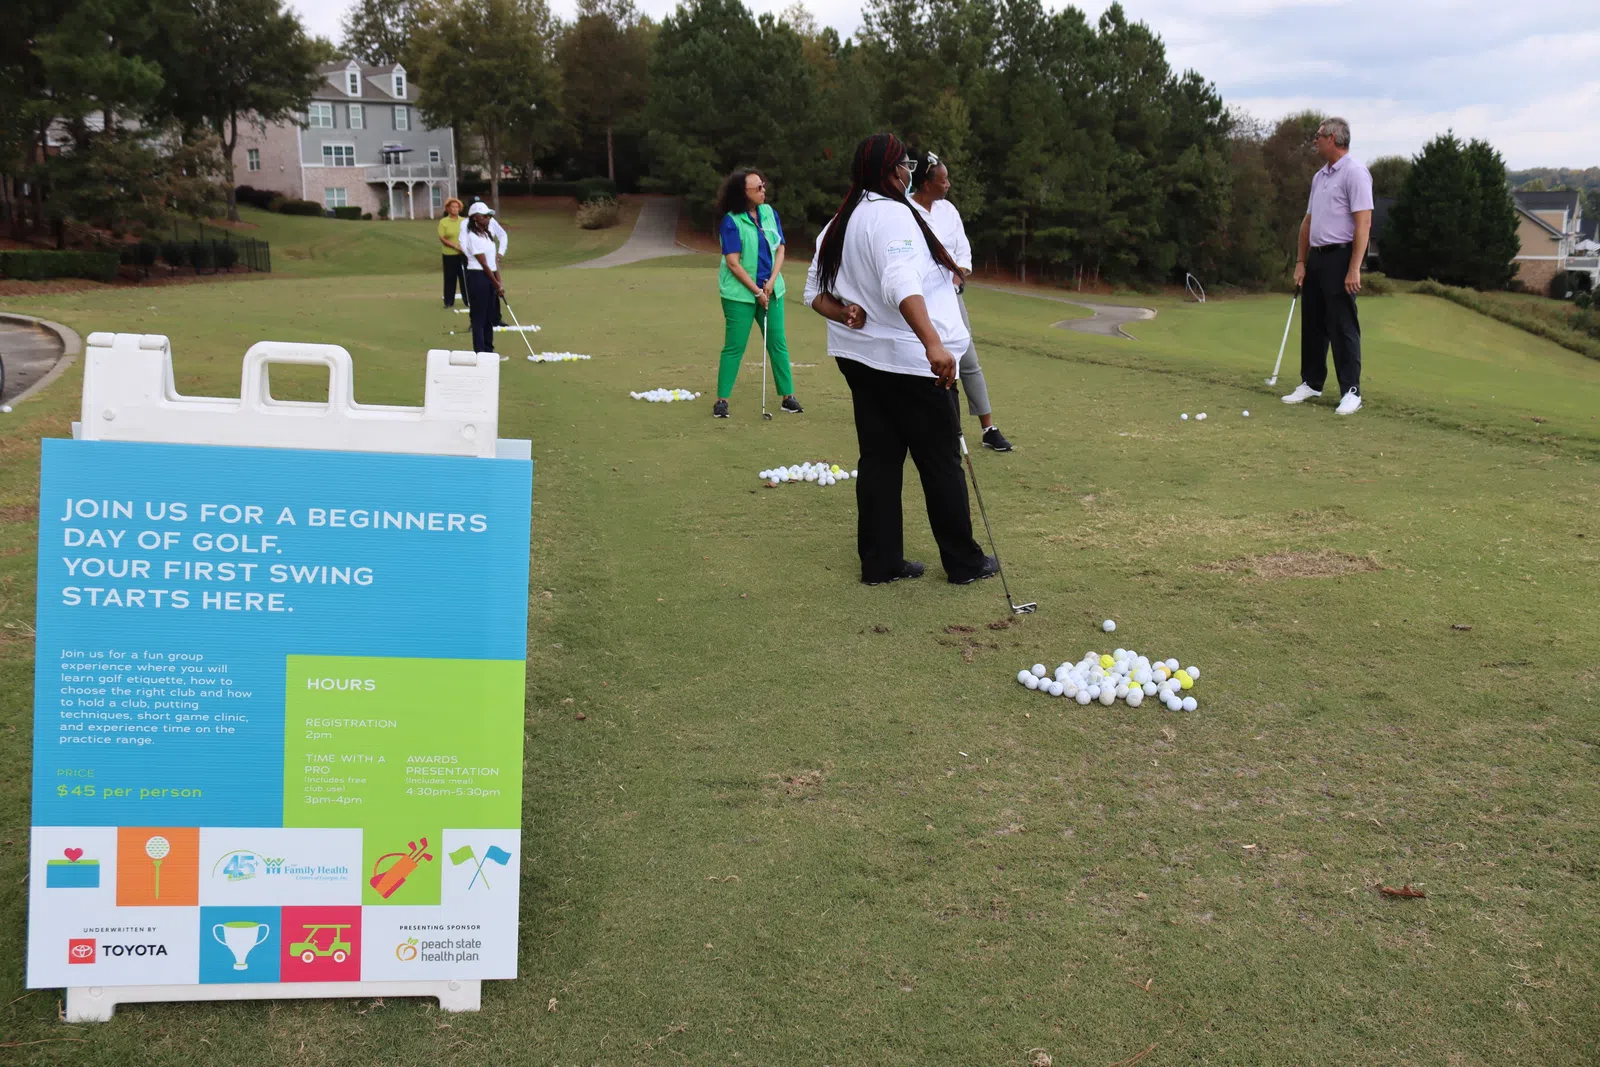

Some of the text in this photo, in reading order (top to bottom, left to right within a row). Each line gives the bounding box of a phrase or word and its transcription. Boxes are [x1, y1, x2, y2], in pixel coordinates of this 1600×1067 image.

[61, 498, 487, 533] JOIN US FOR A BEGINNERS
[64, 528, 283, 554] DAY OF GOLF.
[63, 558, 373, 586] YOUR FIRST SWING
[61, 587, 294, 612] STARTS HERE.
[61, 649, 84, 659] Join
[89, 651, 103, 659] us
[109, 650, 126, 659] for
[144, 651, 163, 660] fun
[168, 652, 203, 662] group
[61, 662, 228, 673] experience where you will
[61, 674, 233, 685] learn golf etiquette, how to
[307, 678, 376, 691] HOURS
[61, 686, 252, 698] choose the right club and how
[78, 698, 104, 707] hold
[154, 700, 199, 710] putting
[60, 710, 249, 723] techniques, short game clinic,
[60, 723, 83, 731] and
[88, 724, 158, 733] experience
[163, 725, 191, 733] time
[215, 725, 235, 734] the
[306, 719, 397, 728] REGISTRATION
[60, 735, 154, 746] practice range.
[305, 731, 332, 740] 2pm
[305, 754, 385, 763] TIME WITH A
[407, 756, 457, 764] AWARDS
[57, 768, 94, 777] PRICE
[305, 766, 330, 774] PRO
[406, 767, 499, 775] PRESENTATION
[57, 784, 202, 800] $45 per person
[406, 788, 500, 796] 4:30pm-5:30pm
[305, 796, 362, 804] 3pm-4pm
[285, 866, 348, 875] Family Health
[422, 939, 481, 950] peach state
[102, 945, 168, 956] TOYOTA
[421, 951, 478, 963] health plan
